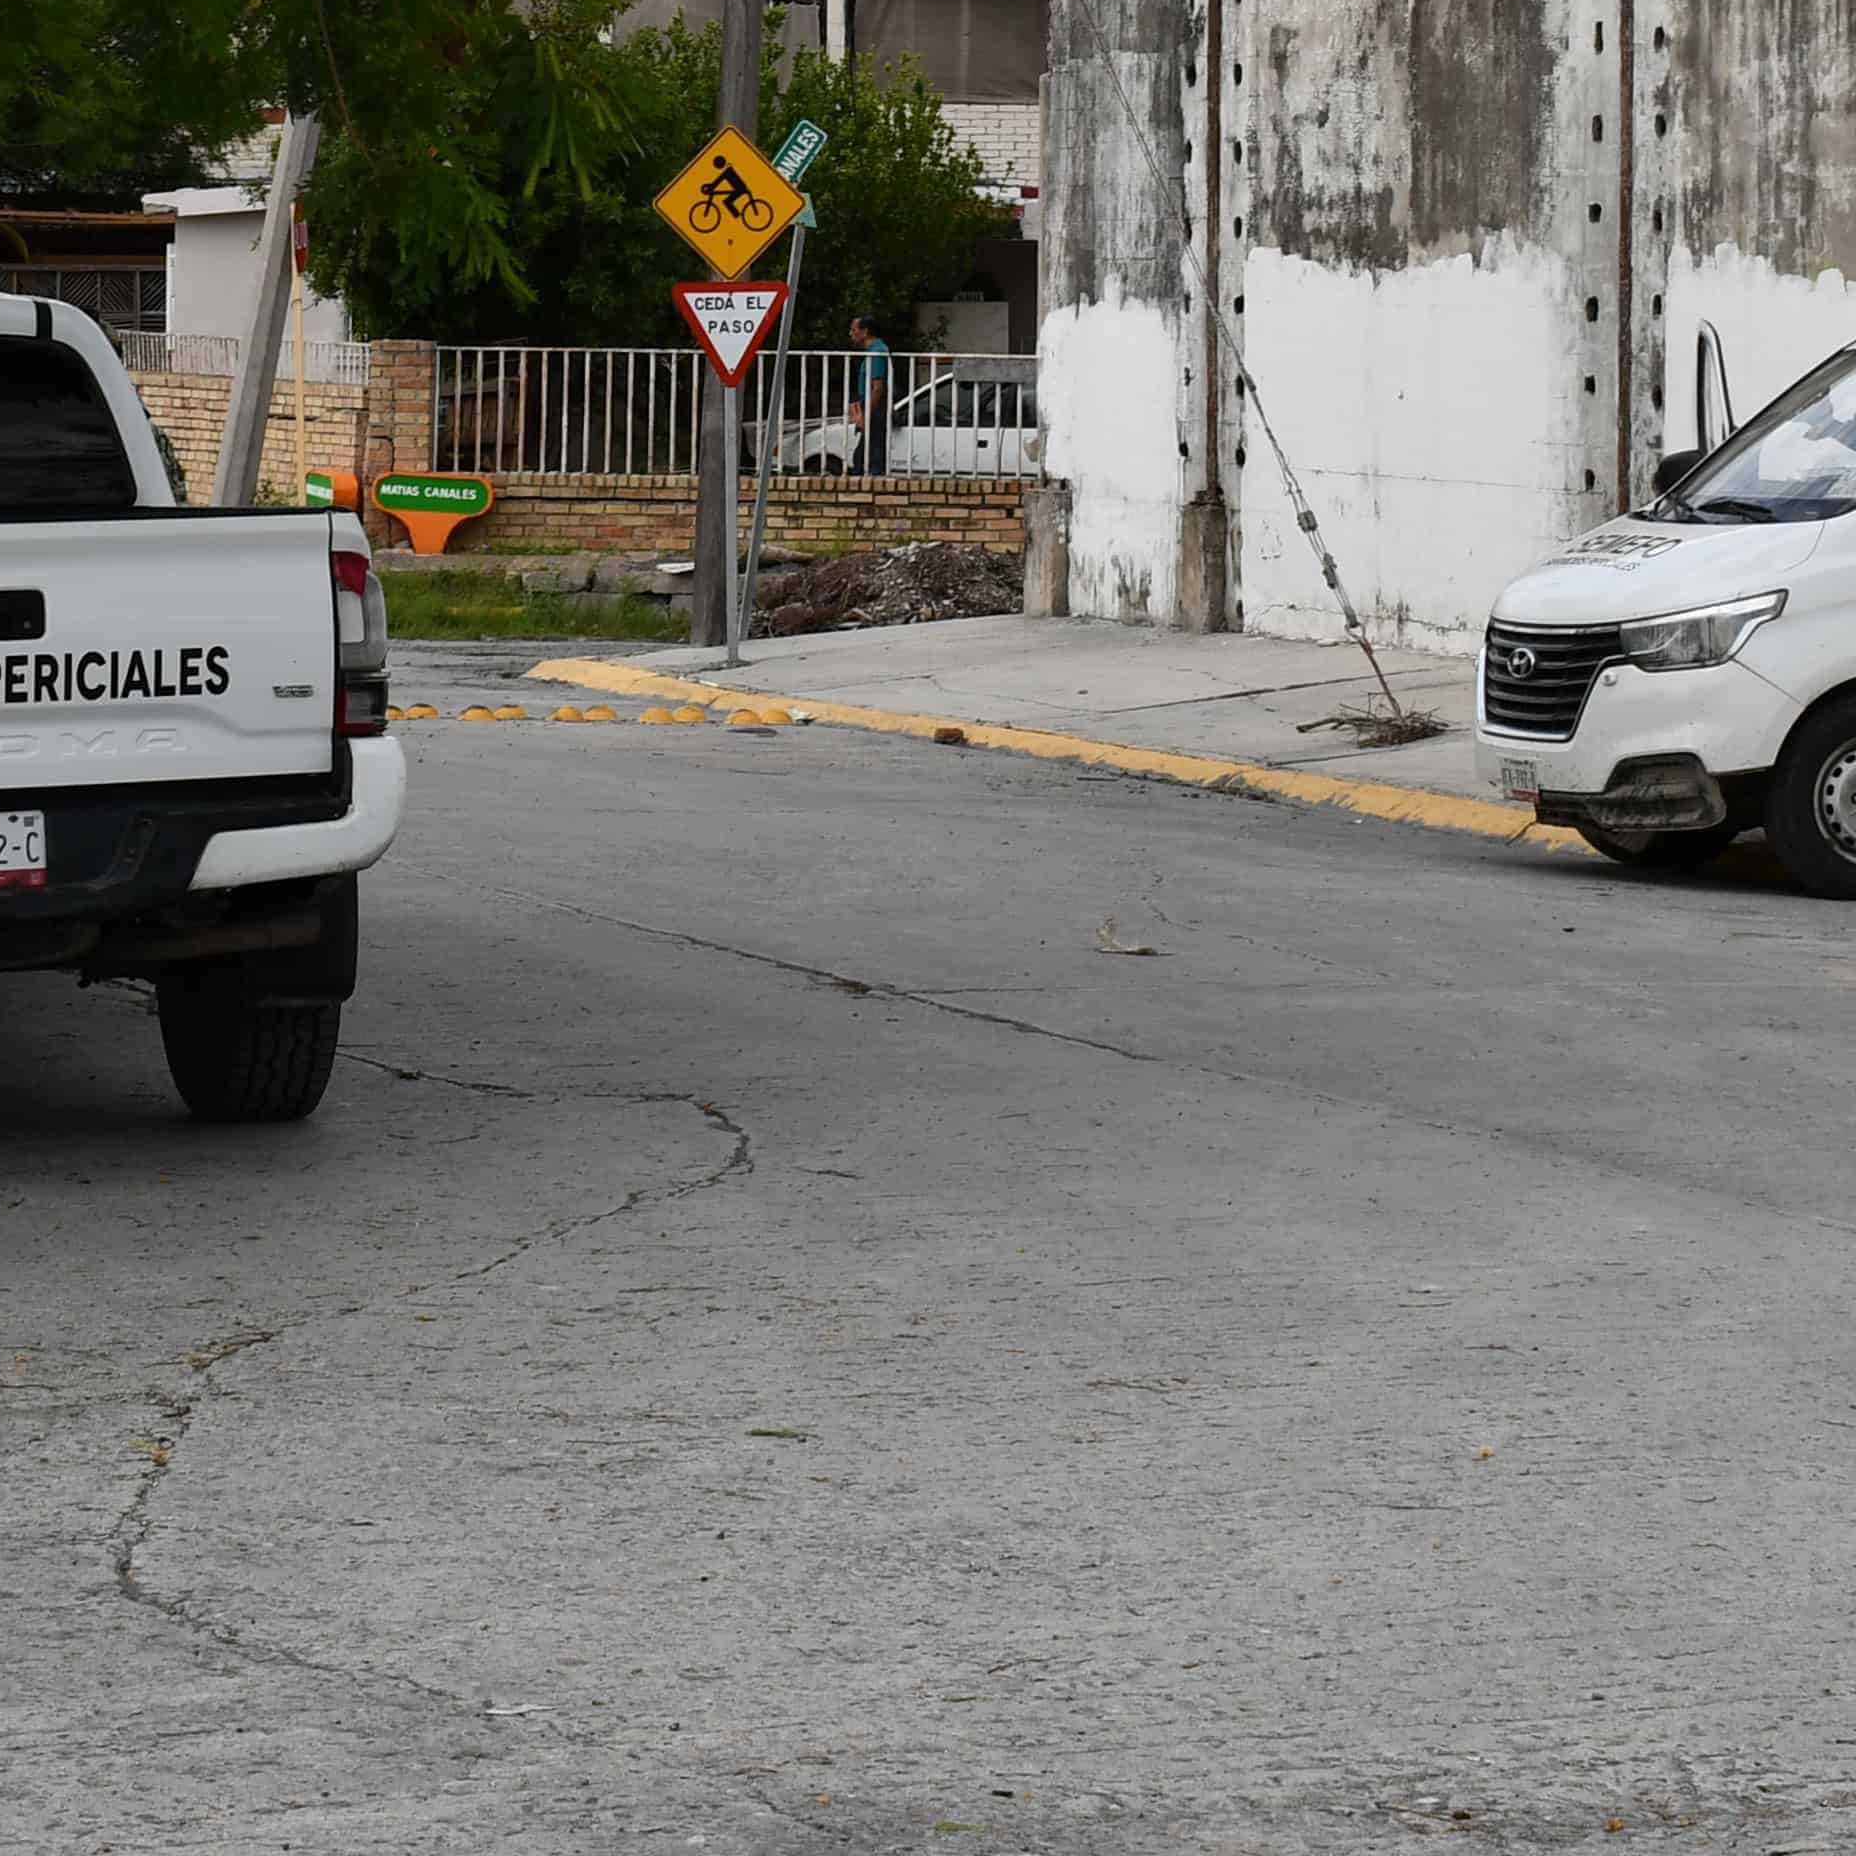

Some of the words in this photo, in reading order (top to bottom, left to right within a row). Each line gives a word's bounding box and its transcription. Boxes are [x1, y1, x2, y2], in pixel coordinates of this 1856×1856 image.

[775, 128, 819, 181] ANALES
[693, 295, 735, 311] CEDA
[745, 295, 767, 311] EL
[707, 319, 755, 334] PASO
[380, 483, 420, 497] MATIAS
[423, 486, 478, 501] CANALES
